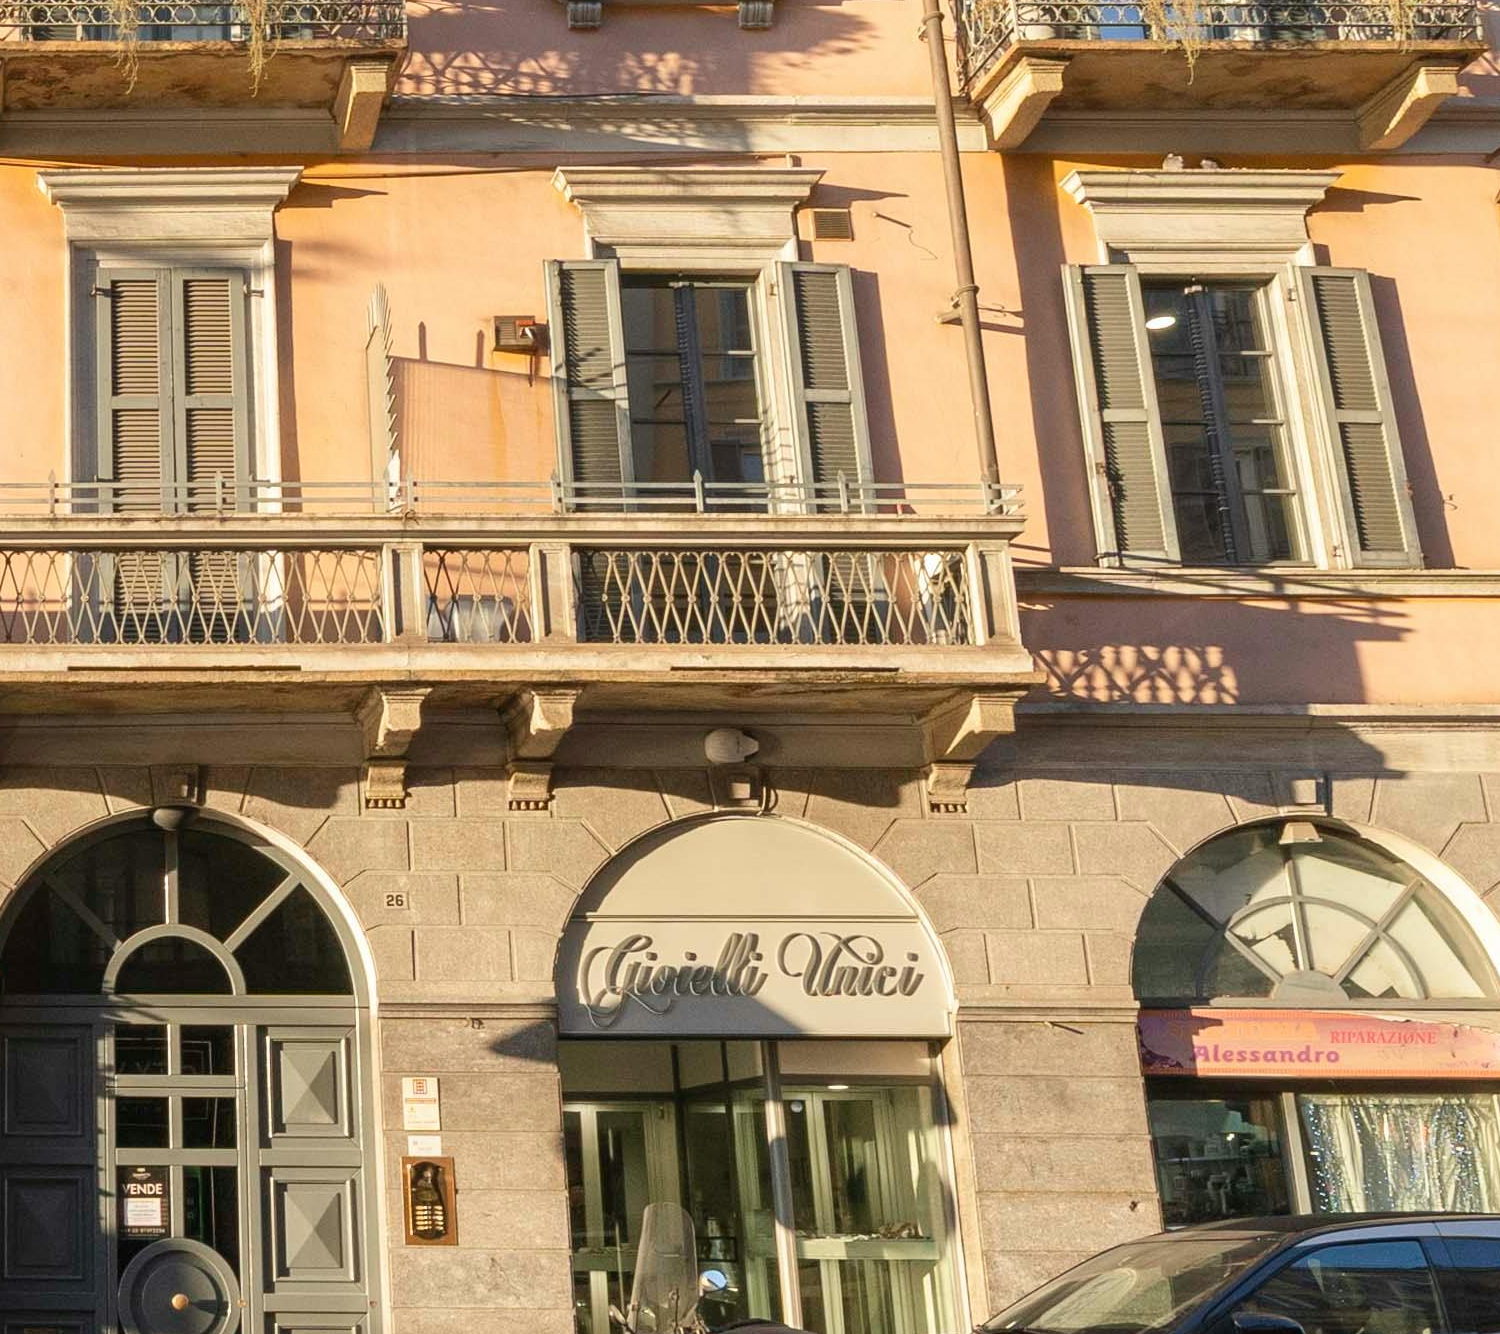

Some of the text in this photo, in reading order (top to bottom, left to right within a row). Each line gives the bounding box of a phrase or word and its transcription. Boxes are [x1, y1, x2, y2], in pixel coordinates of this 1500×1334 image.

[385, 894, 404, 907] 26
[576, 931, 925, 1028] Gioielli Unici
[1191, 1044, 1340, 1064] Alessandro
[122, 1183, 163, 1195] VENDE
